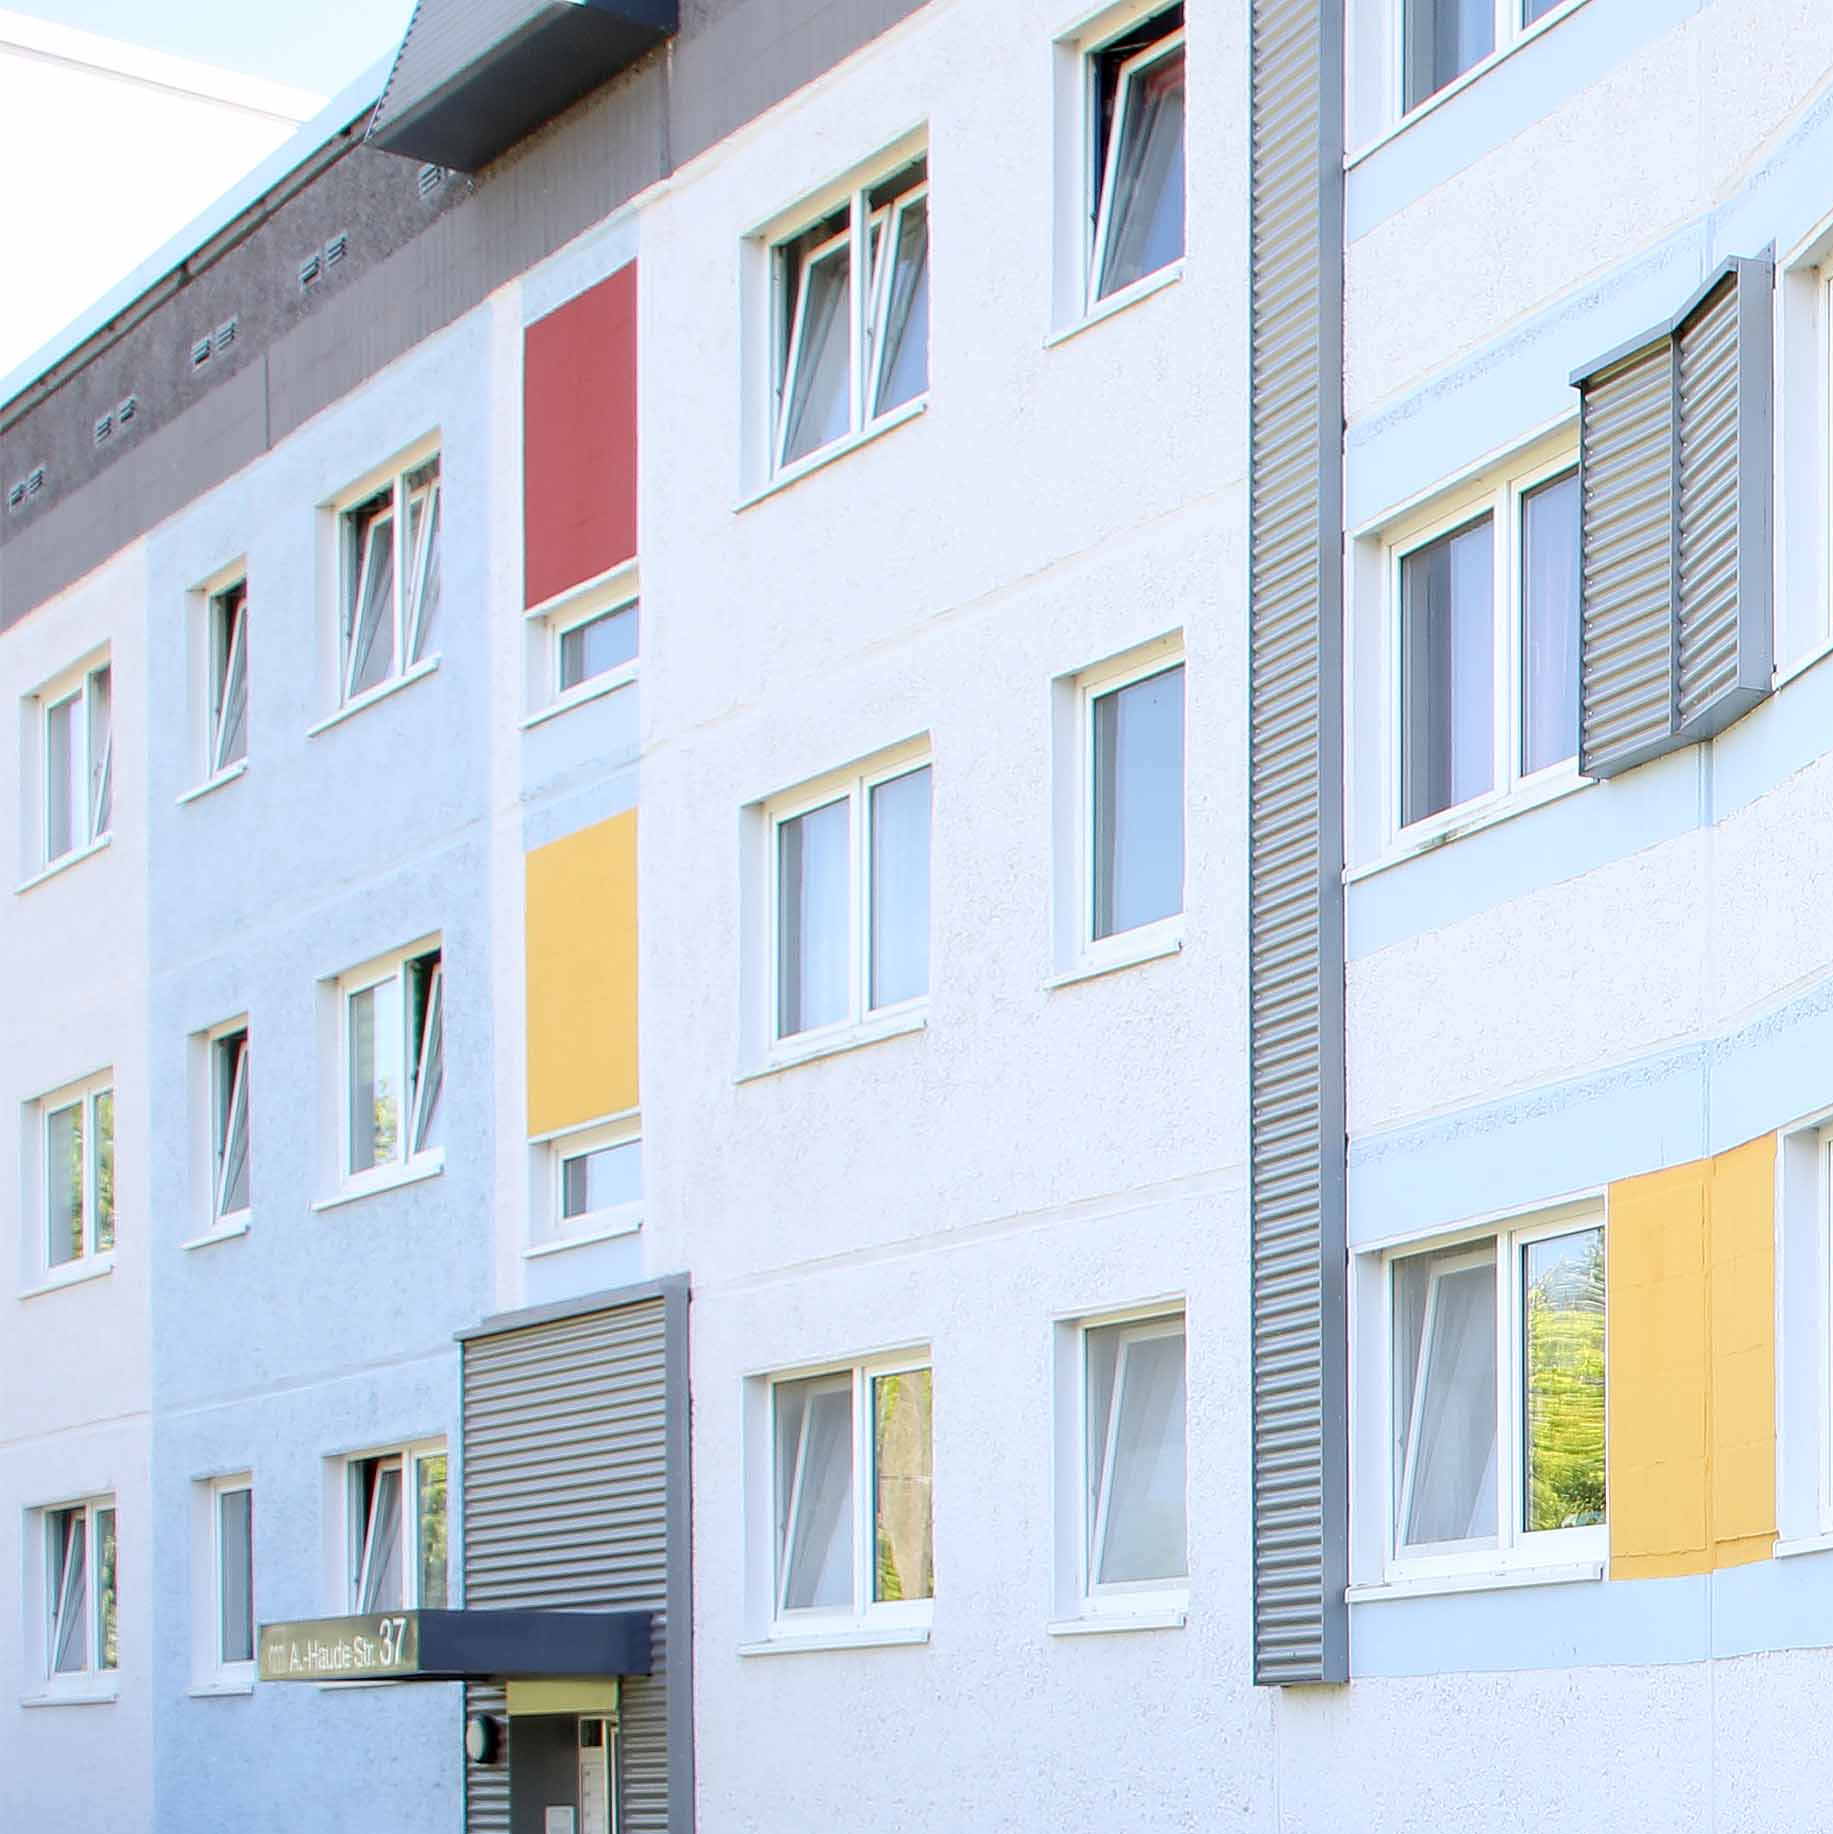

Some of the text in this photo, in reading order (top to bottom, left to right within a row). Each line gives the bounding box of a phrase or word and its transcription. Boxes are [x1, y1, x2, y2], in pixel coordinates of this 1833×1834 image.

[289, 1616, 407, 1673] A.-Haude Str. 37
